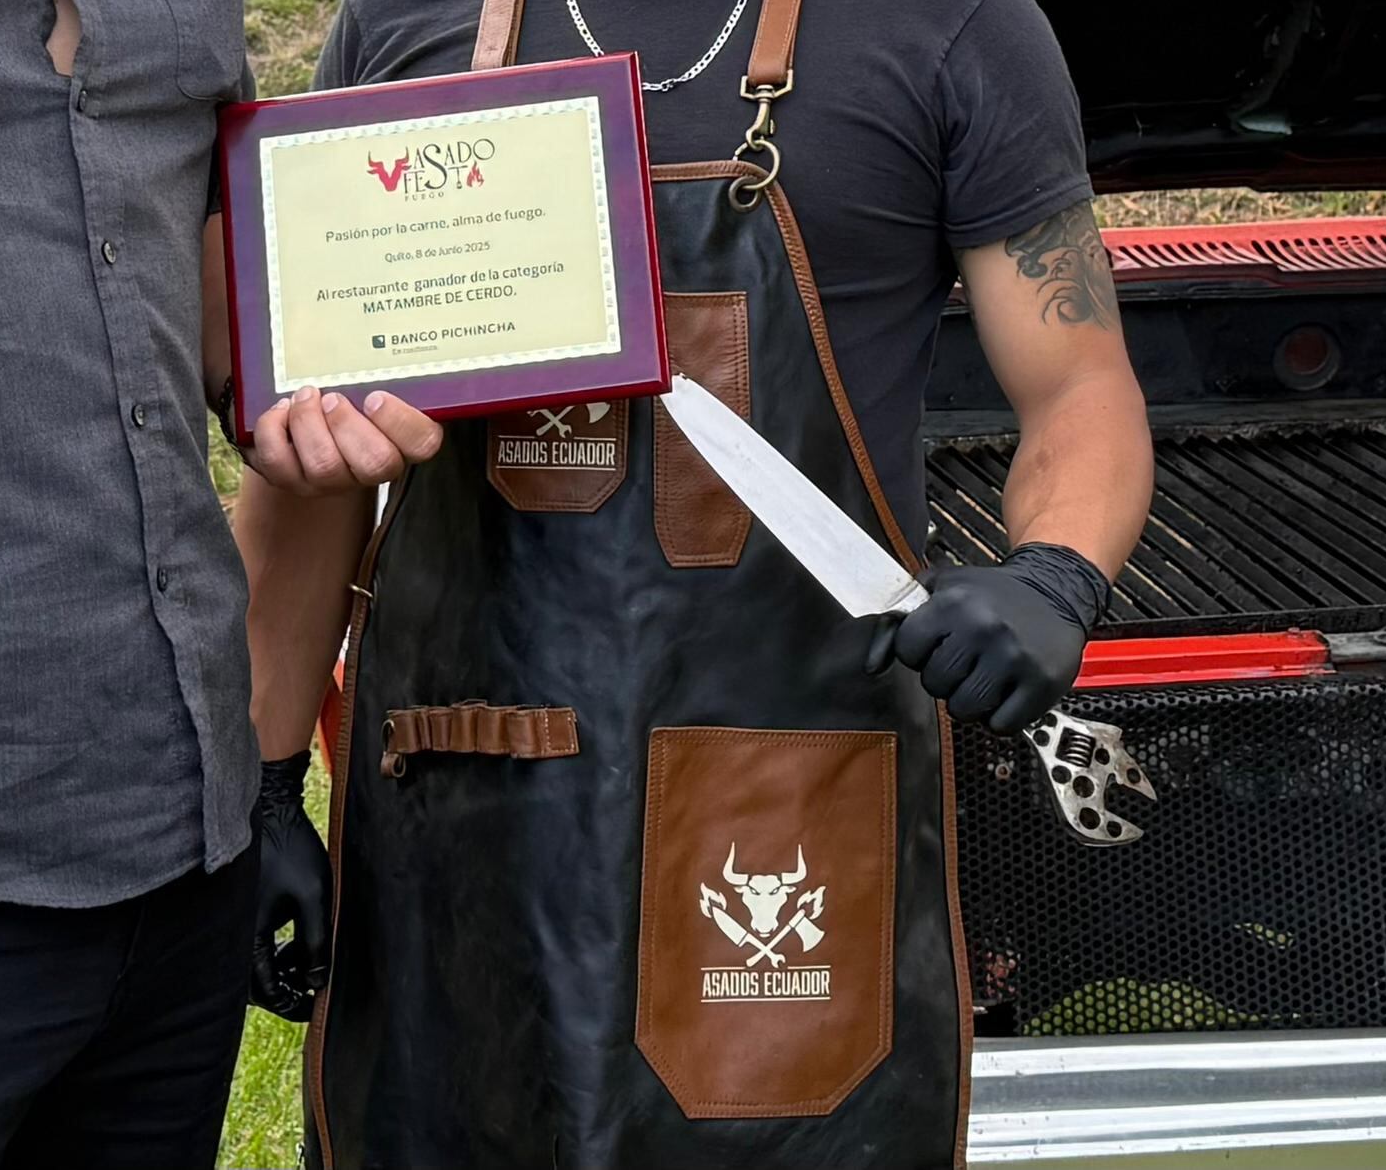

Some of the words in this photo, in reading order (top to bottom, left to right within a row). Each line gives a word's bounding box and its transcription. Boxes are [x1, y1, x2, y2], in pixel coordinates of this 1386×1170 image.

[404, 191, 445, 202] FUEGO
[325, 228, 369, 243] Pasión
[371, 226, 392, 239] por
[396, 222, 407, 234] la
[409, 219, 450, 232] carne,
[452, 215, 483, 227] alma
[485, 212, 502, 223] de
[504, 208, 546, 221] fuego.
[384, 251, 414, 263] Quito,
[415, 249, 423, 259] 8
[424, 248, 437, 257] de
[464, 241, 491, 253] 2025
[316, 288, 329, 302] Al
[332, 281, 409, 299] restaurante
[414, 273, 467, 292] ganador
[470, 270, 486, 283] de
[488, 268, 499, 280] la
[502, 261, 564, 279] categoría
[363, 293, 442, 314] MATAMBRE
[445, 291, 463, 304] DE
[466, 285, 517, 301] CERDO.
[391, 330, 438, 345] BANCO
[441, 322, 516, 339] PICHINCHA
[497, 440, 548, 464] ASADOS
[552, 441, 615, 466] ECUADOR
[702, 971, 759, 997] ASADOS
[764, 970, 831, 996] ECUADOR
